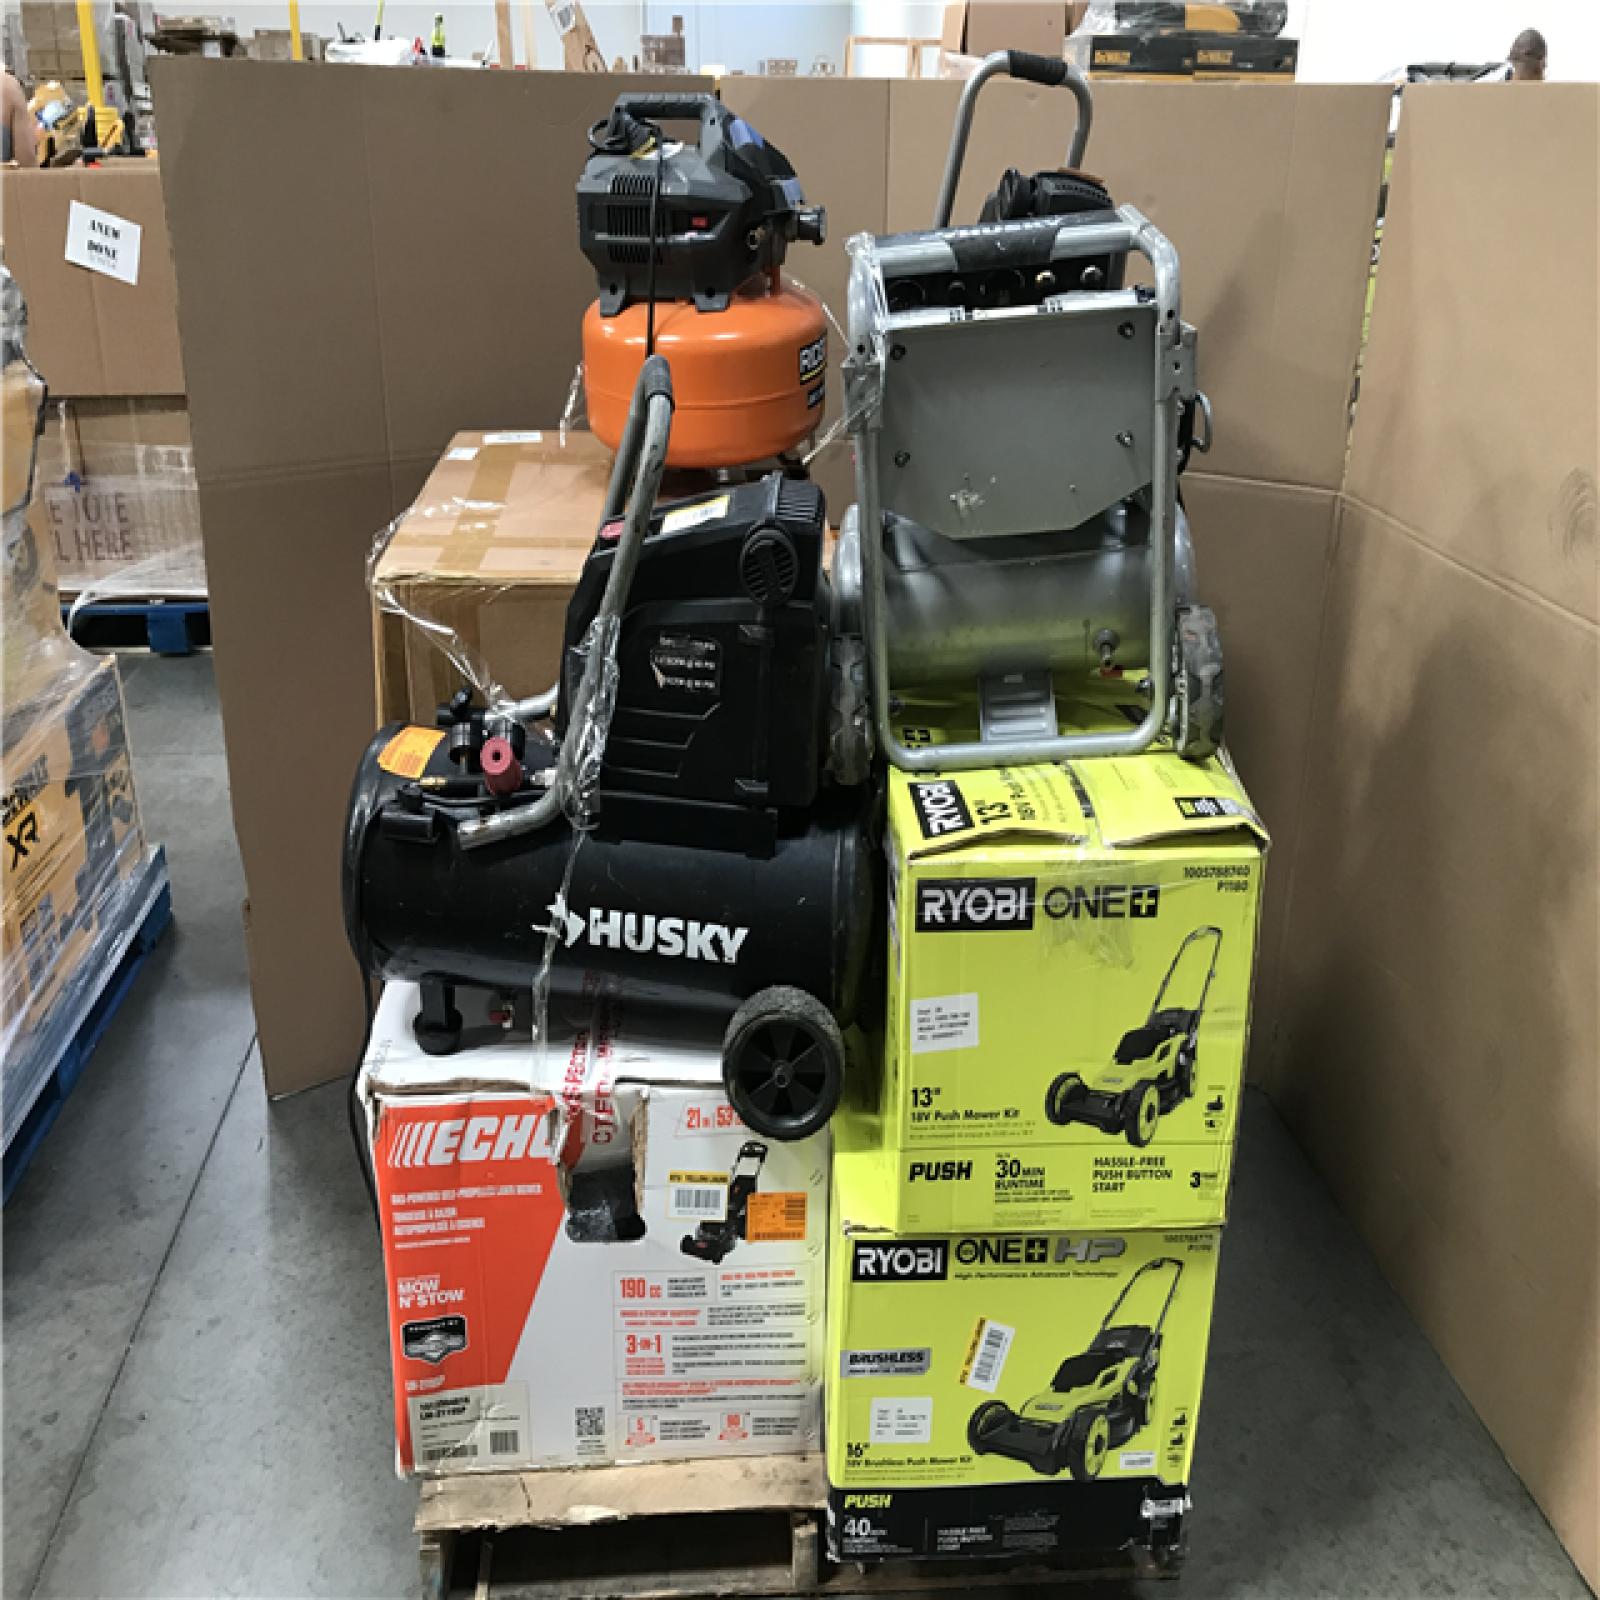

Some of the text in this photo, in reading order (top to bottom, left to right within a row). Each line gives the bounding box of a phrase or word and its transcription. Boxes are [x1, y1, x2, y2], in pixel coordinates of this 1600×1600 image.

[922, 885, 1159, 924] RYOBI ONE+
[589, 906, 749, 964] HUSKY
[911, 1087, 941, 1108] 13"
[687, 1106, 701, 1130] 21
[910, 1106, 1021, 1123] 18V Push Mower Kit
[908, 1159, 974, 1183] PUSH
[994, 1158, 1046, 1179] 30 MIN
[1093, 1155, 1166, 1168] HASSLE-FREE
[994, 1179, 1045, 1190] RUNTIME
[1092, 1169, 1173, 1181] PUSH BUTTON
[1190, 1171, 1201, 1189] 3
[1092, 1181, 1126, 1193] START
[857, 1236, 1128, 1276] RYOBI ONE+ HP
[620, 1276, 646, 1299] 190
[849, 1350, 926, 1365] BRUSHLESS
[844, 1494, 893, 1509] PUSH
[844, 1517, 871, 1536] 40
